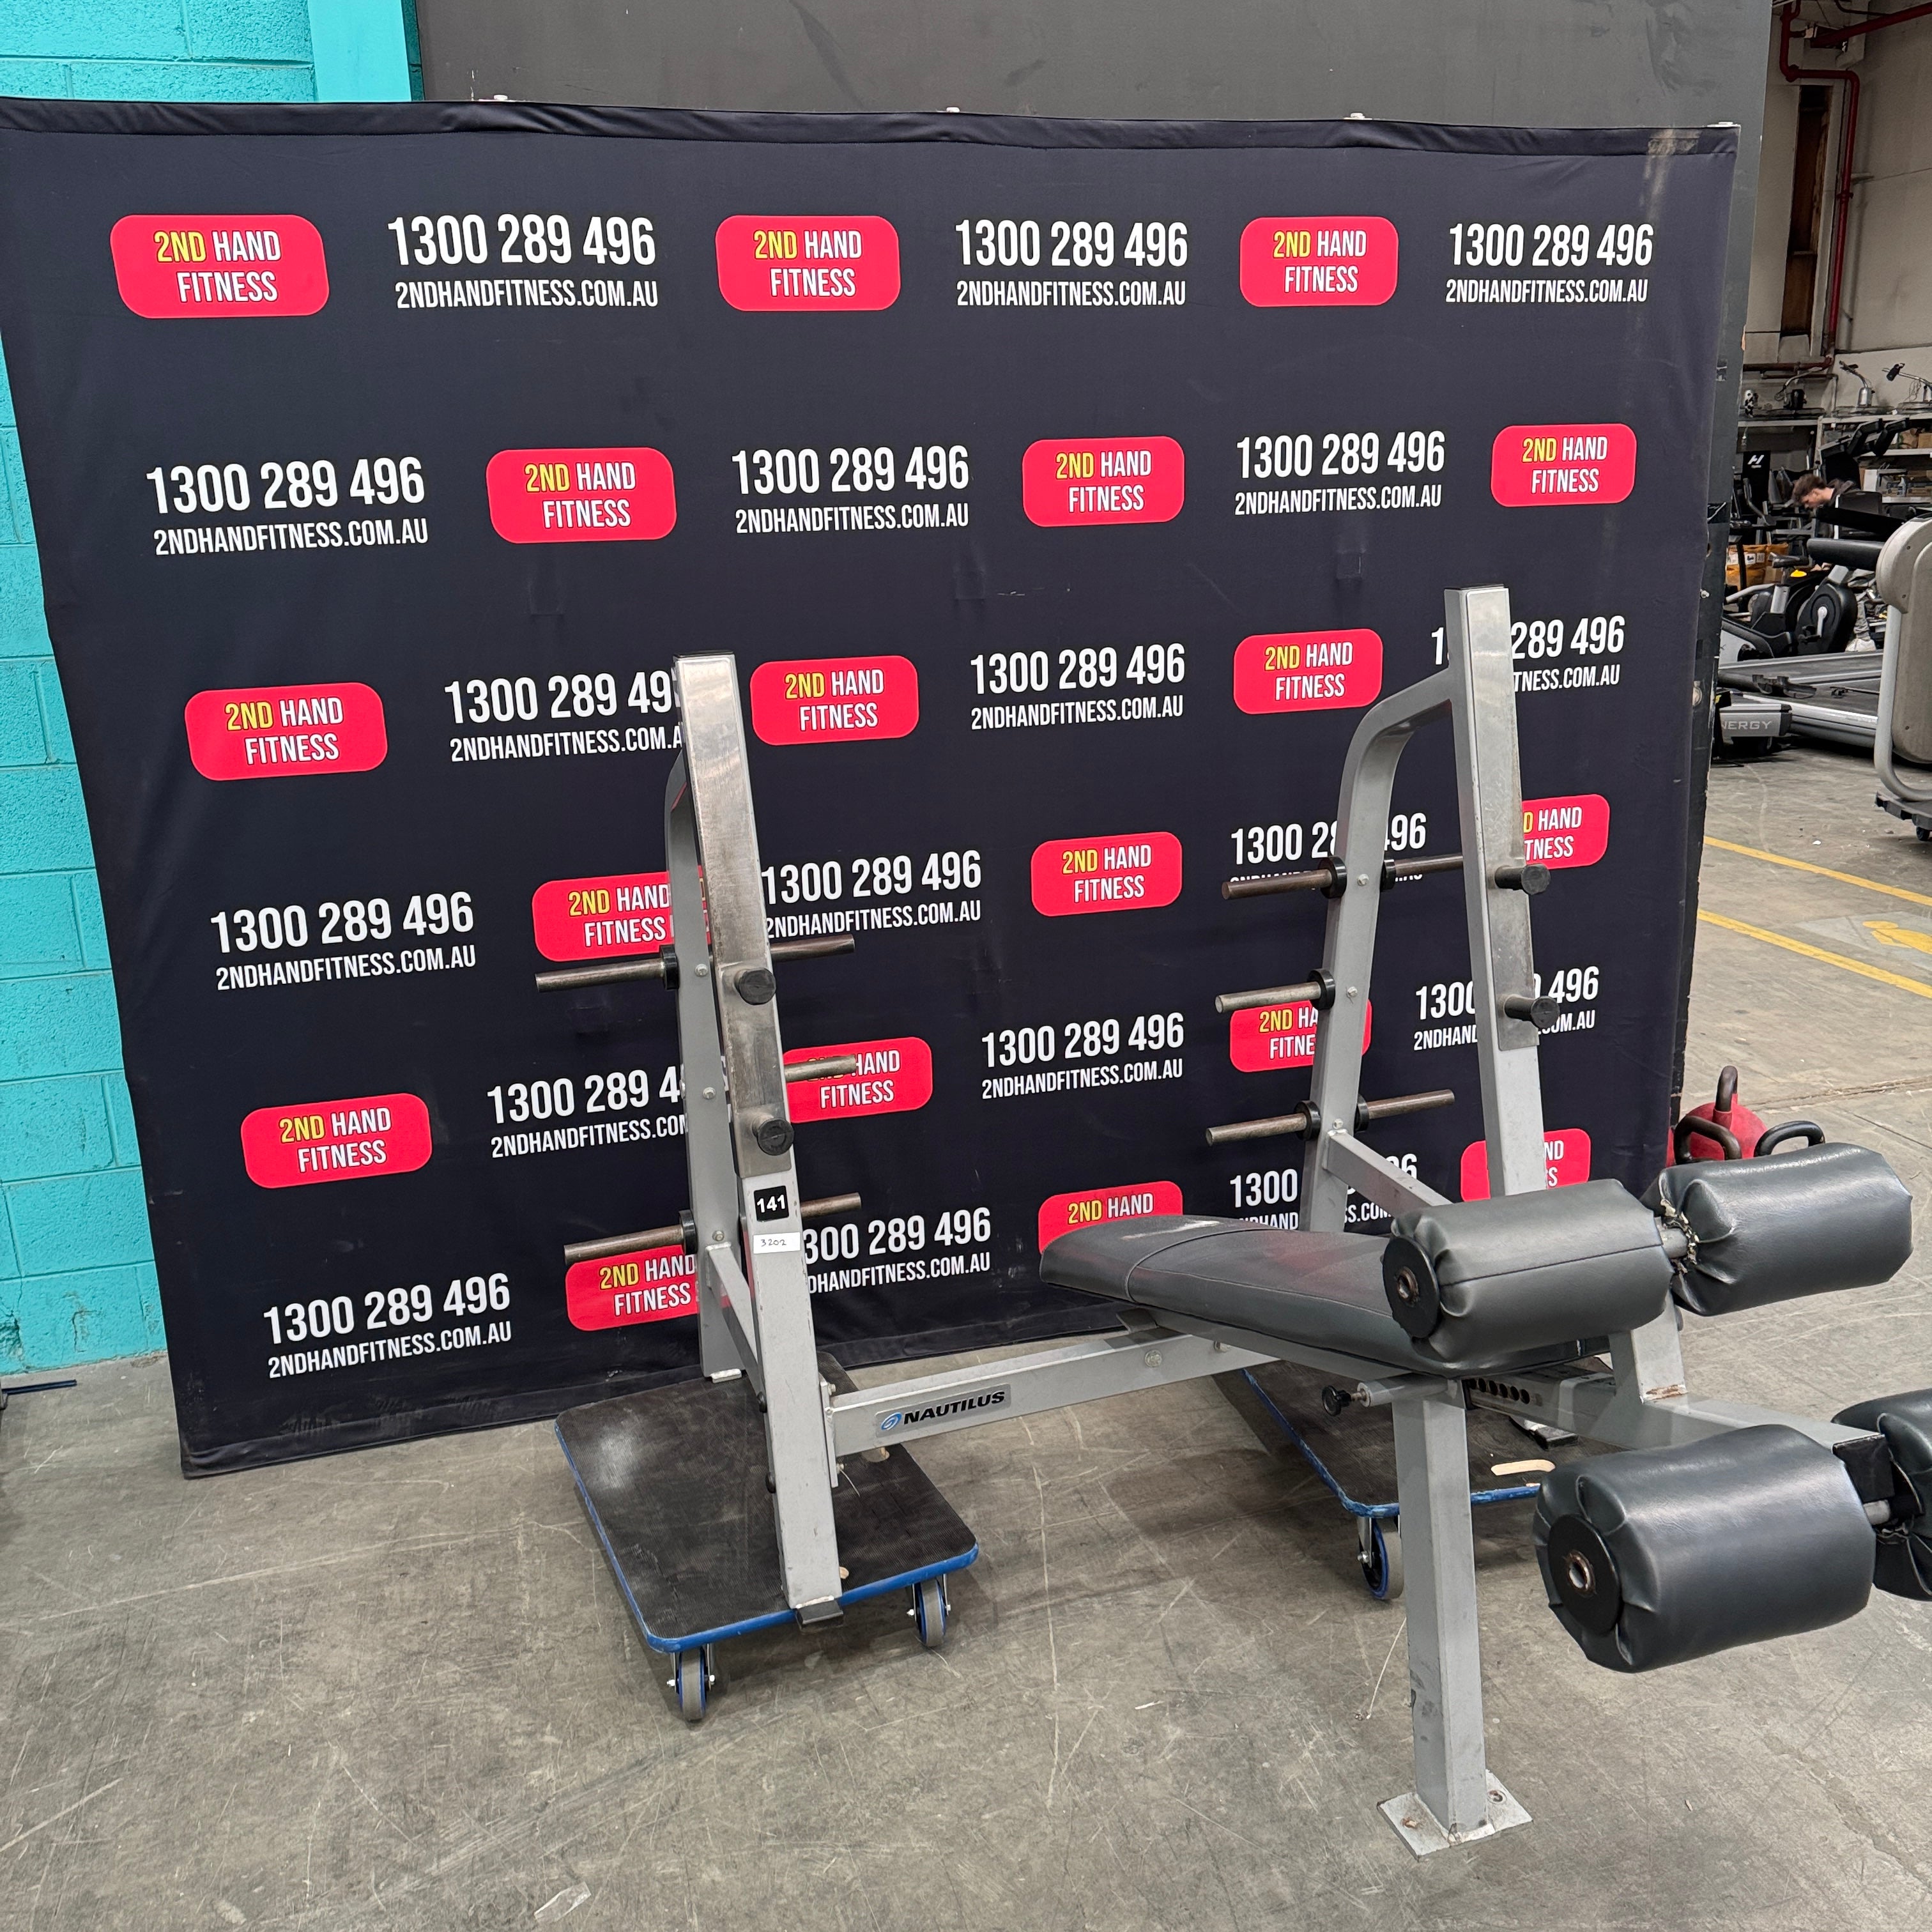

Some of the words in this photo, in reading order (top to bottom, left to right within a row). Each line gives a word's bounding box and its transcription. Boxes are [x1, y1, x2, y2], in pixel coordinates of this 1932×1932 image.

[154, 231, 206, 262] 2ND
[212, 231, 281, 261] HAND
[387, 214, 488, 266] 1300
[497, 213, 572, 264] 289
[583, 216, 656, 266] 496
[754, 230, 797, 259] 2ND
[804, 231, 862, 259] HAND
[955, 219, 1040, 266] 1300
[1051, 220, 1114, 267] 289
[1124, 222, 1188, 267] 496
[1273, 231, 1311, 258] 2ND
[1317, 230, 1367, 257] HAND
[1450, 223, 1524, 266] 1300
[1531, 224, 1590, 267] 289
[1596, 224, 1654, 266] 496
[177, 271, 278, 302] FITNESS
[395, 279, 658, 309] 2NDHANDFITNESS.COM.AU
[770, 268, 855, 296] FITNESS
[956, 280, 1186, 306] 2NDHANDFITNESS.COM.AU
[1285, 265, 1358, 293] FITNESS
[1445, 279, 1648, 303] 2NDHANDFITNESS.COM.AU
[1056, 452, 1094, 479] 2ND
[1101, 450, 1151, 477] HAND
[1236, 434, 1313, 479] 1300
[1321, 432, 1379, 475] 289
[1387, 430, 1445, 473] 496
[1522, 438, 1557, 463] 2ND
[1562, 436, 1608, 461] HAND
[146, 463, 250, 514] 1300
[260, 459, 338, 509] 289
[349, 456, 425, 505] 496
[525, 464, 570, 492] 2ND
[576, 462, 636, 491] HAND
[732, 448, 820, 494] 1300
[830, 447, 895, 493] 289
[905, 445, 969, 490] 496
[1531, 468, 1599, 494] FITNESS
[543, 499, 631, 528] FITNESS
[1069, 484, 1144, 512] FITNESS
[1234, 484, 1442, 516] 2NDHANDFITNESS.COM.AU
[735, 503, 969, 533] 2NDHANDFITNESS.COM.AU
[153, 518, 428, 556] 2NDHANDFITNESS.COM.AU
[1511, 619, 1564, 659] 289
[1570, 615, 1625, 655] 496
[970, 650, 1048, 694] 1300
[1059, 647, 1117, 689] 289
[1126, 643, 1185, 685] 496
[1265, 645, 1300, 670] 2ND
[1306, 641, 1353, 668] HAND
[785, 673, 825, 699] 2ND
[831, 669, 884, 696] HAND
[1275, 673, 1345, 700] FITNESS
[1514, 664, 1620, 692] TNESS.COM.AU
[444, 677, 539, 724] 1300
[548, 673, 617, 719] 289
[627, 670, 672, 714] 49
[971, 694, 1183, 730] 2NDHANDFITNESS.COM.AU
[225, 702, 273, 730] 2ND
[280, 697, 343, 726] HAND
[800, 702, 878, 731] FITNESS
[245, 733, 339, 765] FITNESS
[450, 721, 682, 762] 2NDHANDFITNESS.COM.A
[1384, 813, 1427, 852] 96
[1538, 806, 1583, 831] HAND
[1062, 849, 1098, 874] 2ND
[1104, 845, 1151, 870] HAND
[1231, 824, 1303, 865] 1300
[1524, 835, 1574, 861] TNESS
[761, 861, 842, 905] 1300
[852, 855, 912, 898] 289
[921, 850, 981, 891] 496
[1075, 875, 1144, 903] FITNESS
[569, 889, 610, 916] 2ND
[617, 883, 670, 912] HAND
[210, 905, 308, 953] 1300
[318, 898, 392, 944] 289
[402, 891, 473, 936] 496
[585, 916, 666, 947] FITNESS
[766, 900, 981, 938] 2NDHANDFITNESS.COM.AU
[216, 944, 476, 990] 2NDHANDFITNESS.COM.AU
[1548, 965, 1599, 1004] 496
[1259, 1009, 1292, 1032] 2ND
[1298, 1006, 1319, 1029] HA
[981, 1025, 1055, 1068] 1300
[1064, 1018, 1119, 1059] 289
[1128, 1012, 1184, 1051] 496
[1269, 1034, 1315, 1060] FITNE
[820, 1079, 894, 1108] FITNESS
[982, 1058, 1183, 1100] 2NDHANDFITNESS.COM.AU
[487, 1078, 575, 1124] 1300
[585, 1070, 649, 1113] 289
[279, 1116, 325, 1143] 2ND
[331, 1107, 391, 1137] HAND
[491, 1114, 686, 1159] 2NDHANDFITNESS.CO
[298, 1139, 387, 1172] FITNESS
[1544, 1140, 1564, 1161] ND
[756, 1194, 786, 1213] 141
[1230, 1169, 1298, 1208] 1300
[1068, 1200, 1102, 1224] 2ND
[1108, 1193, 1153, 1218] HAND
[761, 1239, 786, 1247] 3202
[802, 1223, 859, 1265] 300
[868, 1215, 925, 1255] 289
[934, 1207, 991, 1246] 496
[600, 1263, 639, 1289] 2ND
[645, 1254, 695, 1282] HAND
[807, 1252, 990, 1293] DHANDFITNESS.COM.AU
[263, 1296, 355, 1344] 1300
[364, 1284, 433, 1330] 289
[443, 1273, 510, 1316] 496
[615, 1282, 691, 1315] FITNESS
[268, 1321, 511, 1379] 2NDHANDFITNESS.COM.AU
[903, 1391, 1005, 1425] NAUTILUS
